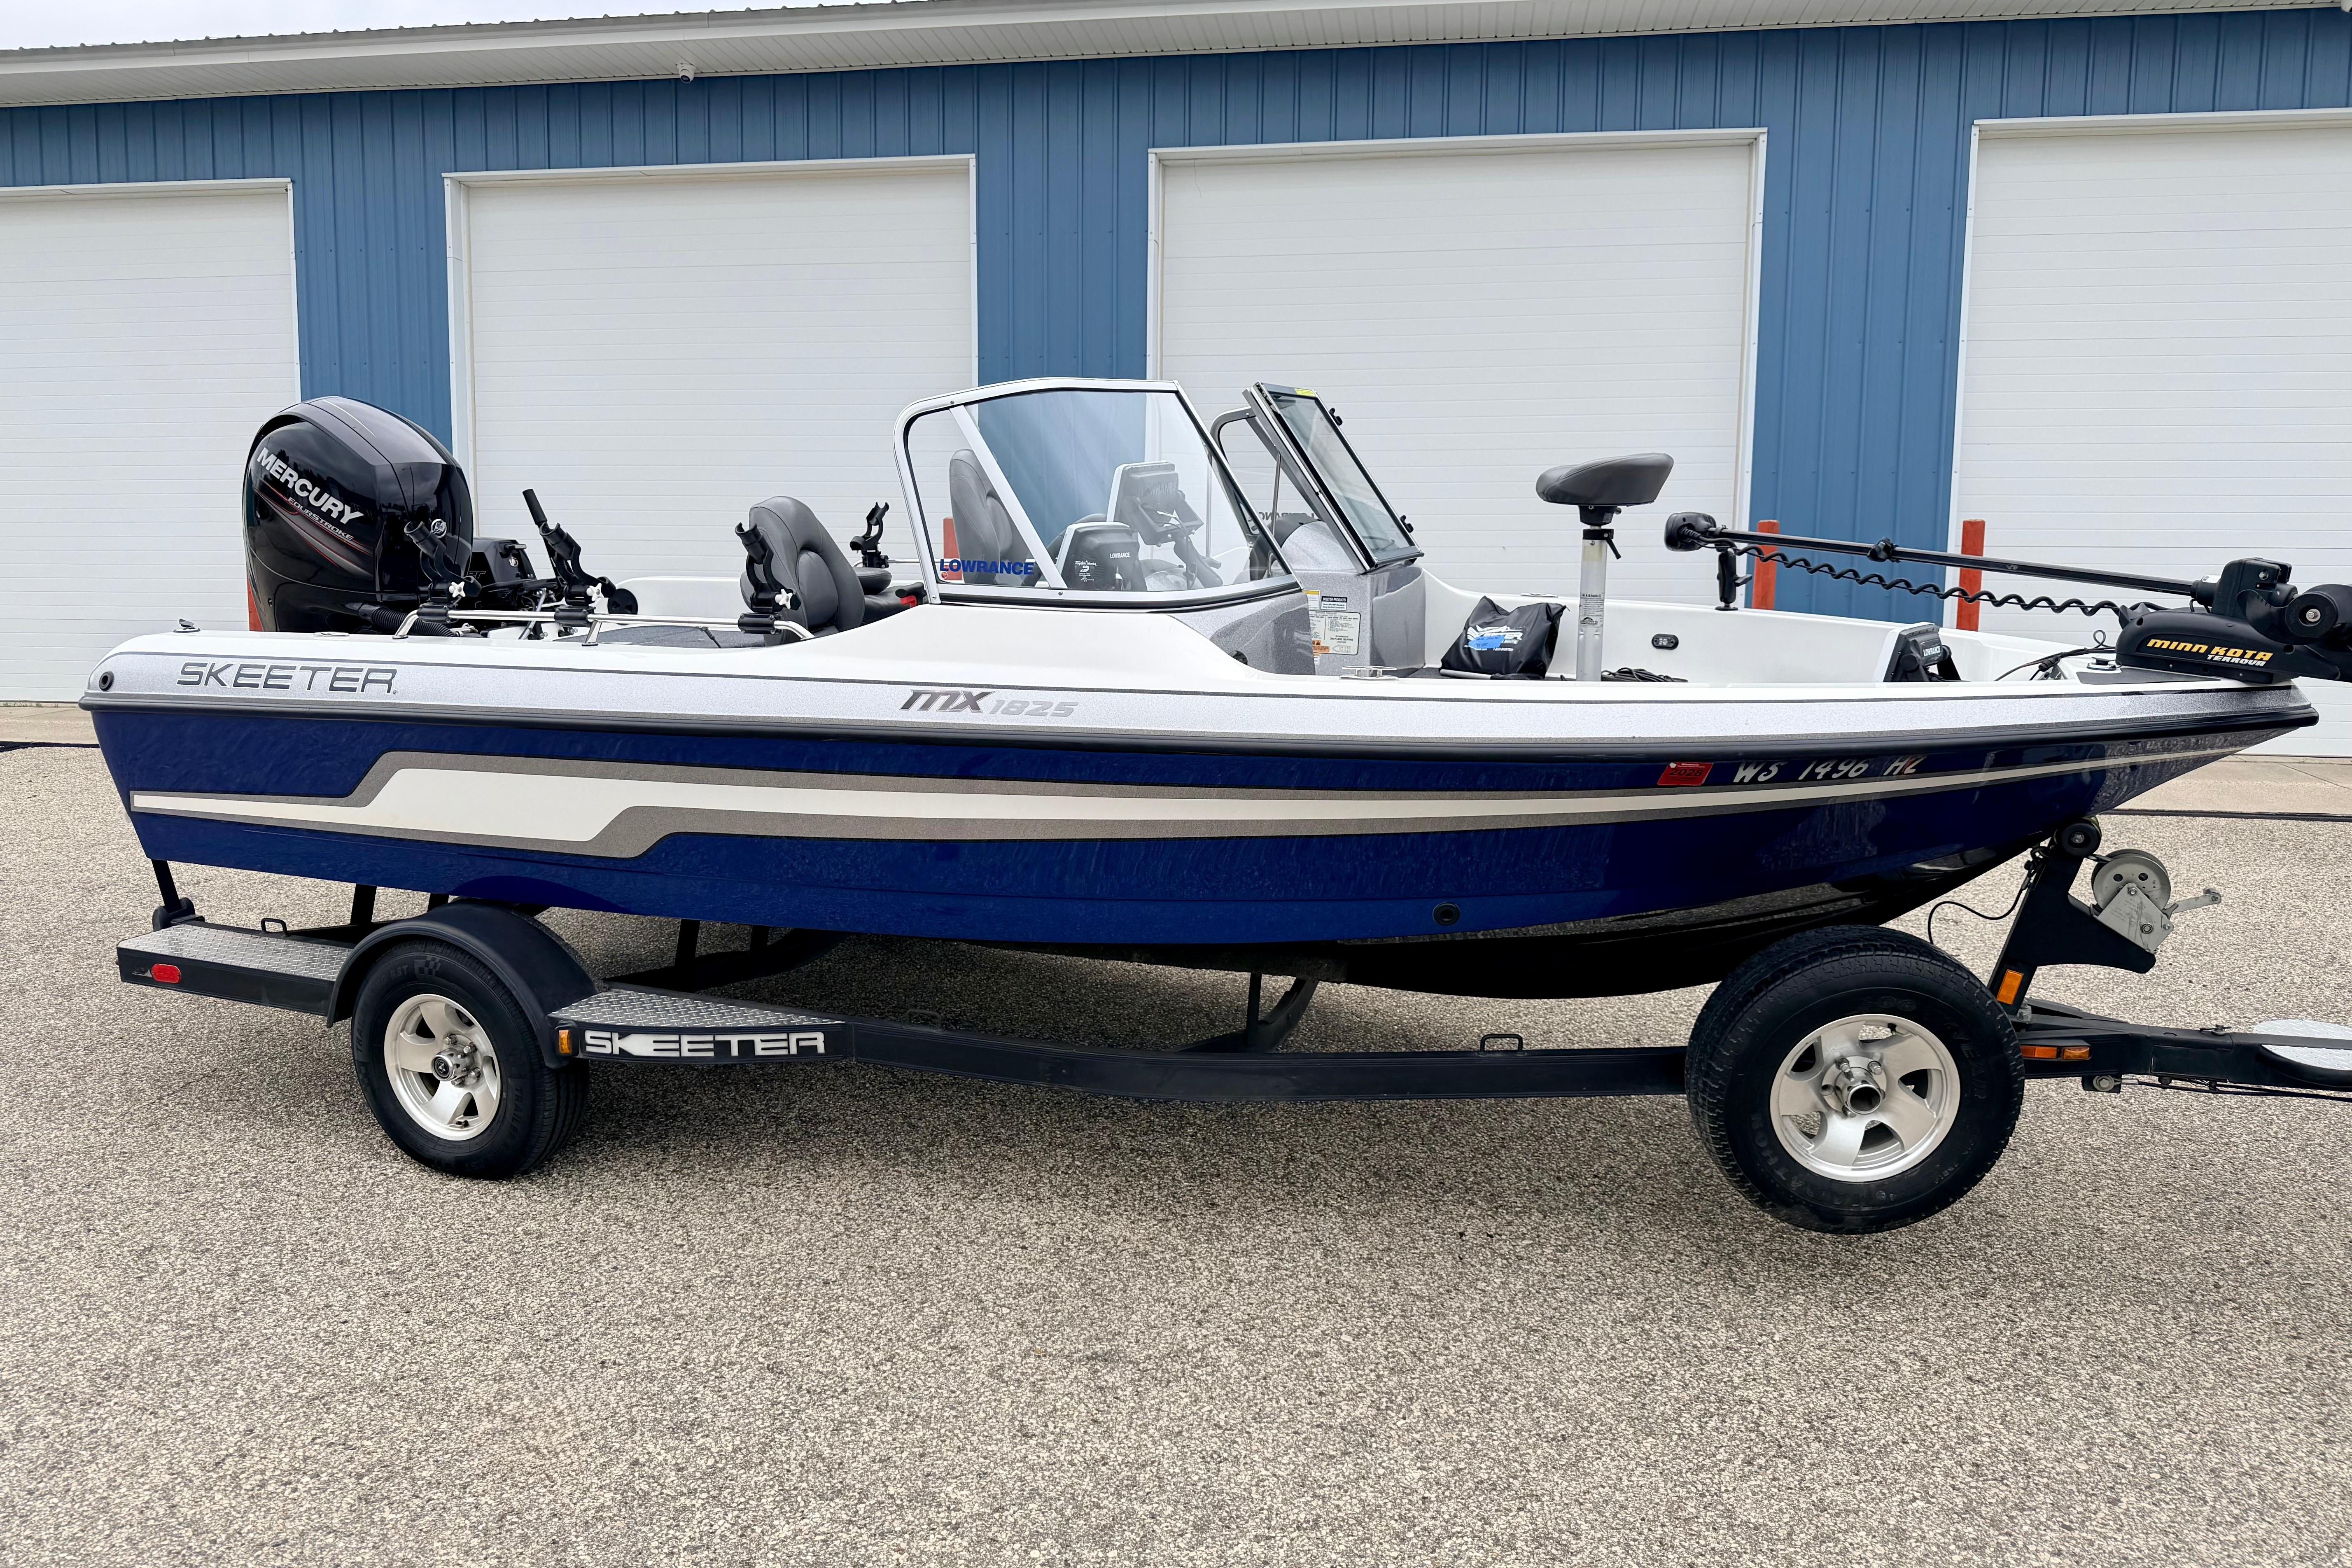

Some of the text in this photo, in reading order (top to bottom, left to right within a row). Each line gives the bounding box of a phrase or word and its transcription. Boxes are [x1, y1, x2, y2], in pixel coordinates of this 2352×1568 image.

[257, 447, 364, 524] MERCURY
[288, 497, 354, 541] FOURSTROKE
[940, 559, 1034, 575] LOWRANCE
[2147, 639, 2273, 660] MINN KOTA
[2207, 654, 2266, 666] TERROVA
[176, 662, 397, 694] SKEETER
[989, 700, 1079, 717] 1825
[1668, 768, 1704, 777] 2028
[1733, 760, 1787, 782] WS
[1798, 758, 1870, 780] 1496
[585, 1030, 825, 1057] SKEETER
